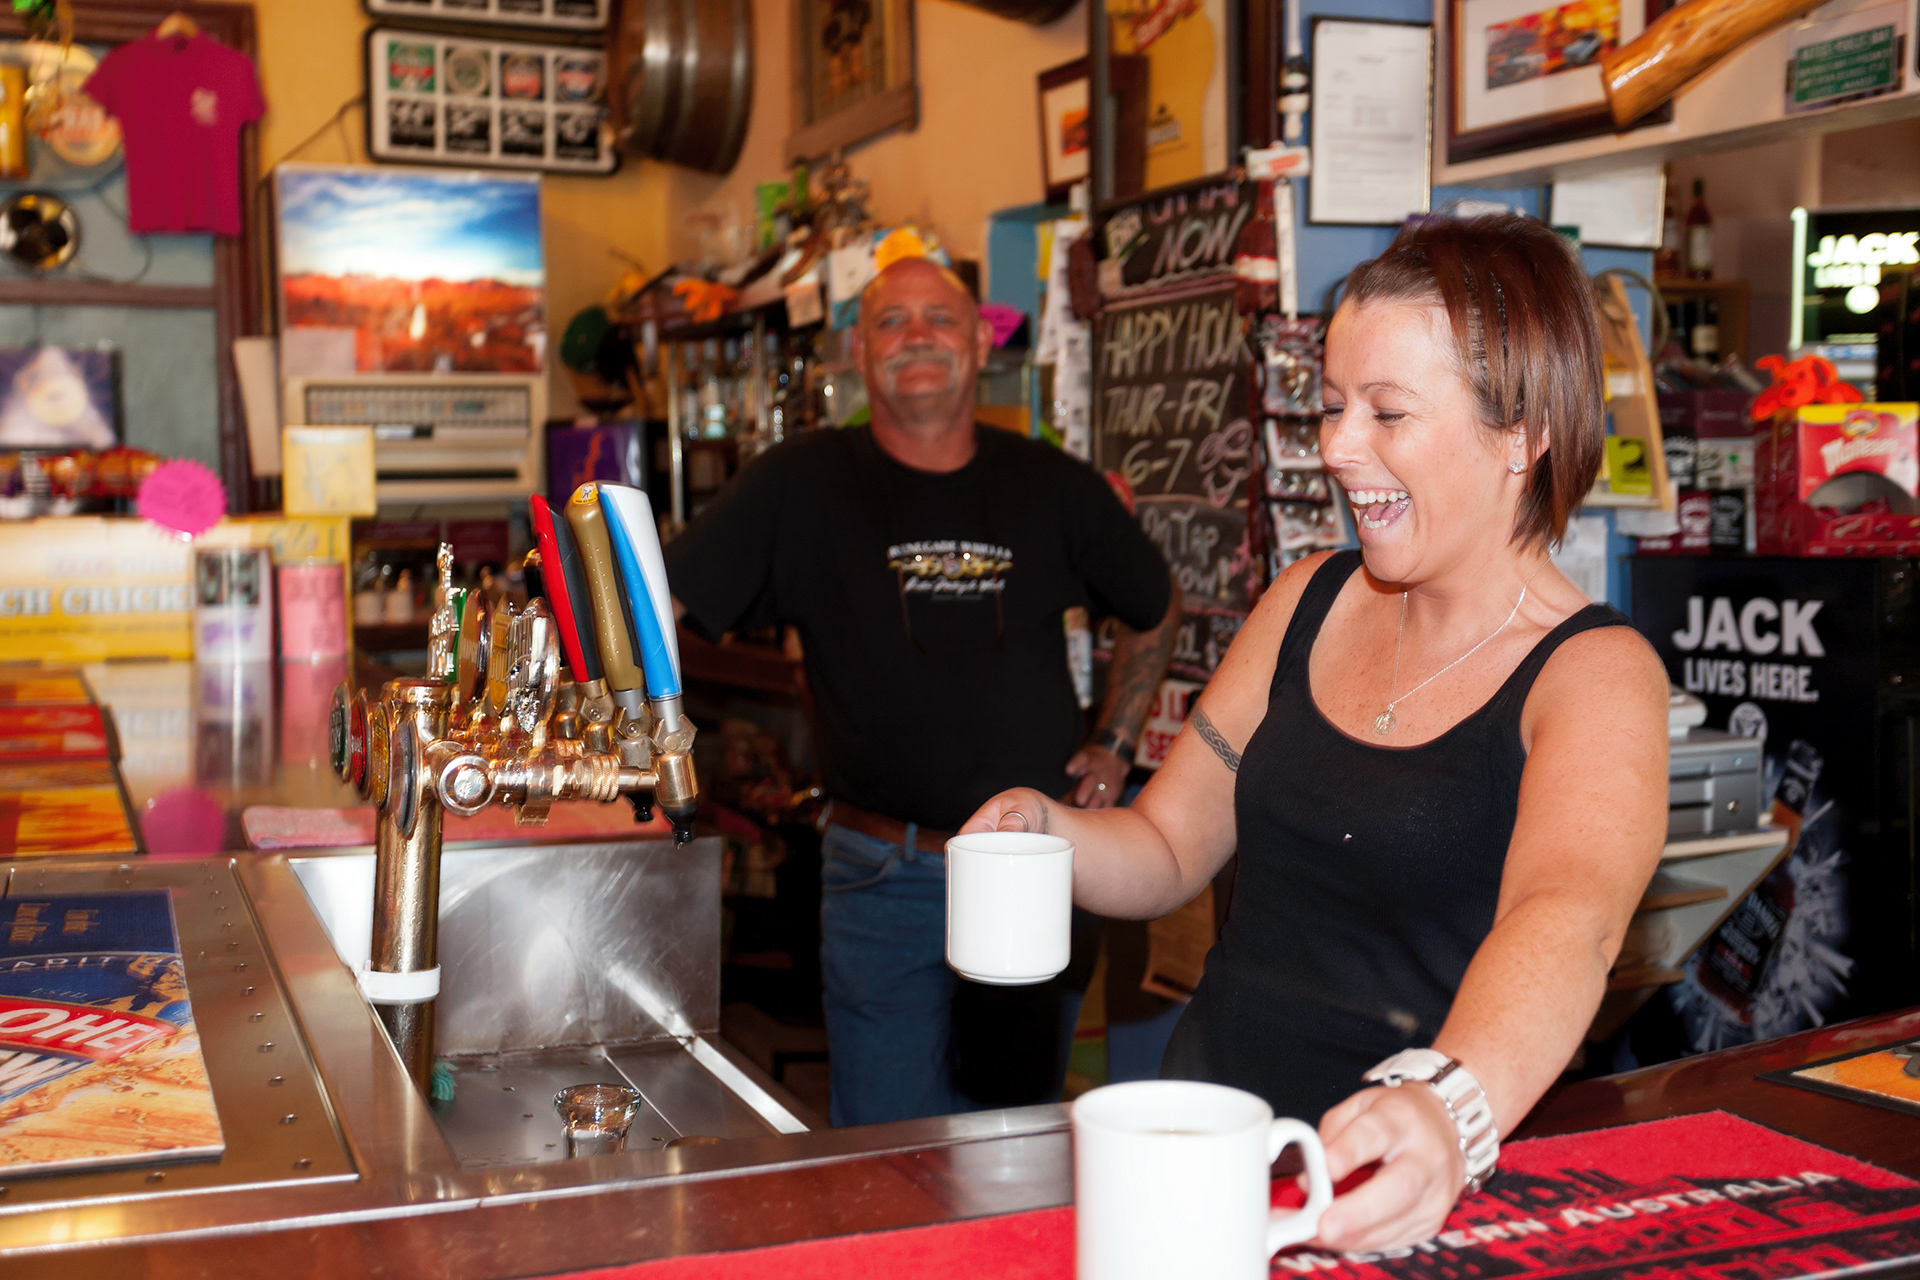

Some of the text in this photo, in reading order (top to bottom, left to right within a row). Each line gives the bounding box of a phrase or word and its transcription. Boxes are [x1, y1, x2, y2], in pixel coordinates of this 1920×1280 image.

[1151, 202, 1249, 277] NOW
[1807, 231, 1919, 267] JACK
[1100, 303, 1188, 377] HAPPY
[1672, 596, 1826, 657] JACK
[1684, 658, 1820, 703] LIVES HERE.
[1560, 1171, 1839, 1226] AUSTRALIA
